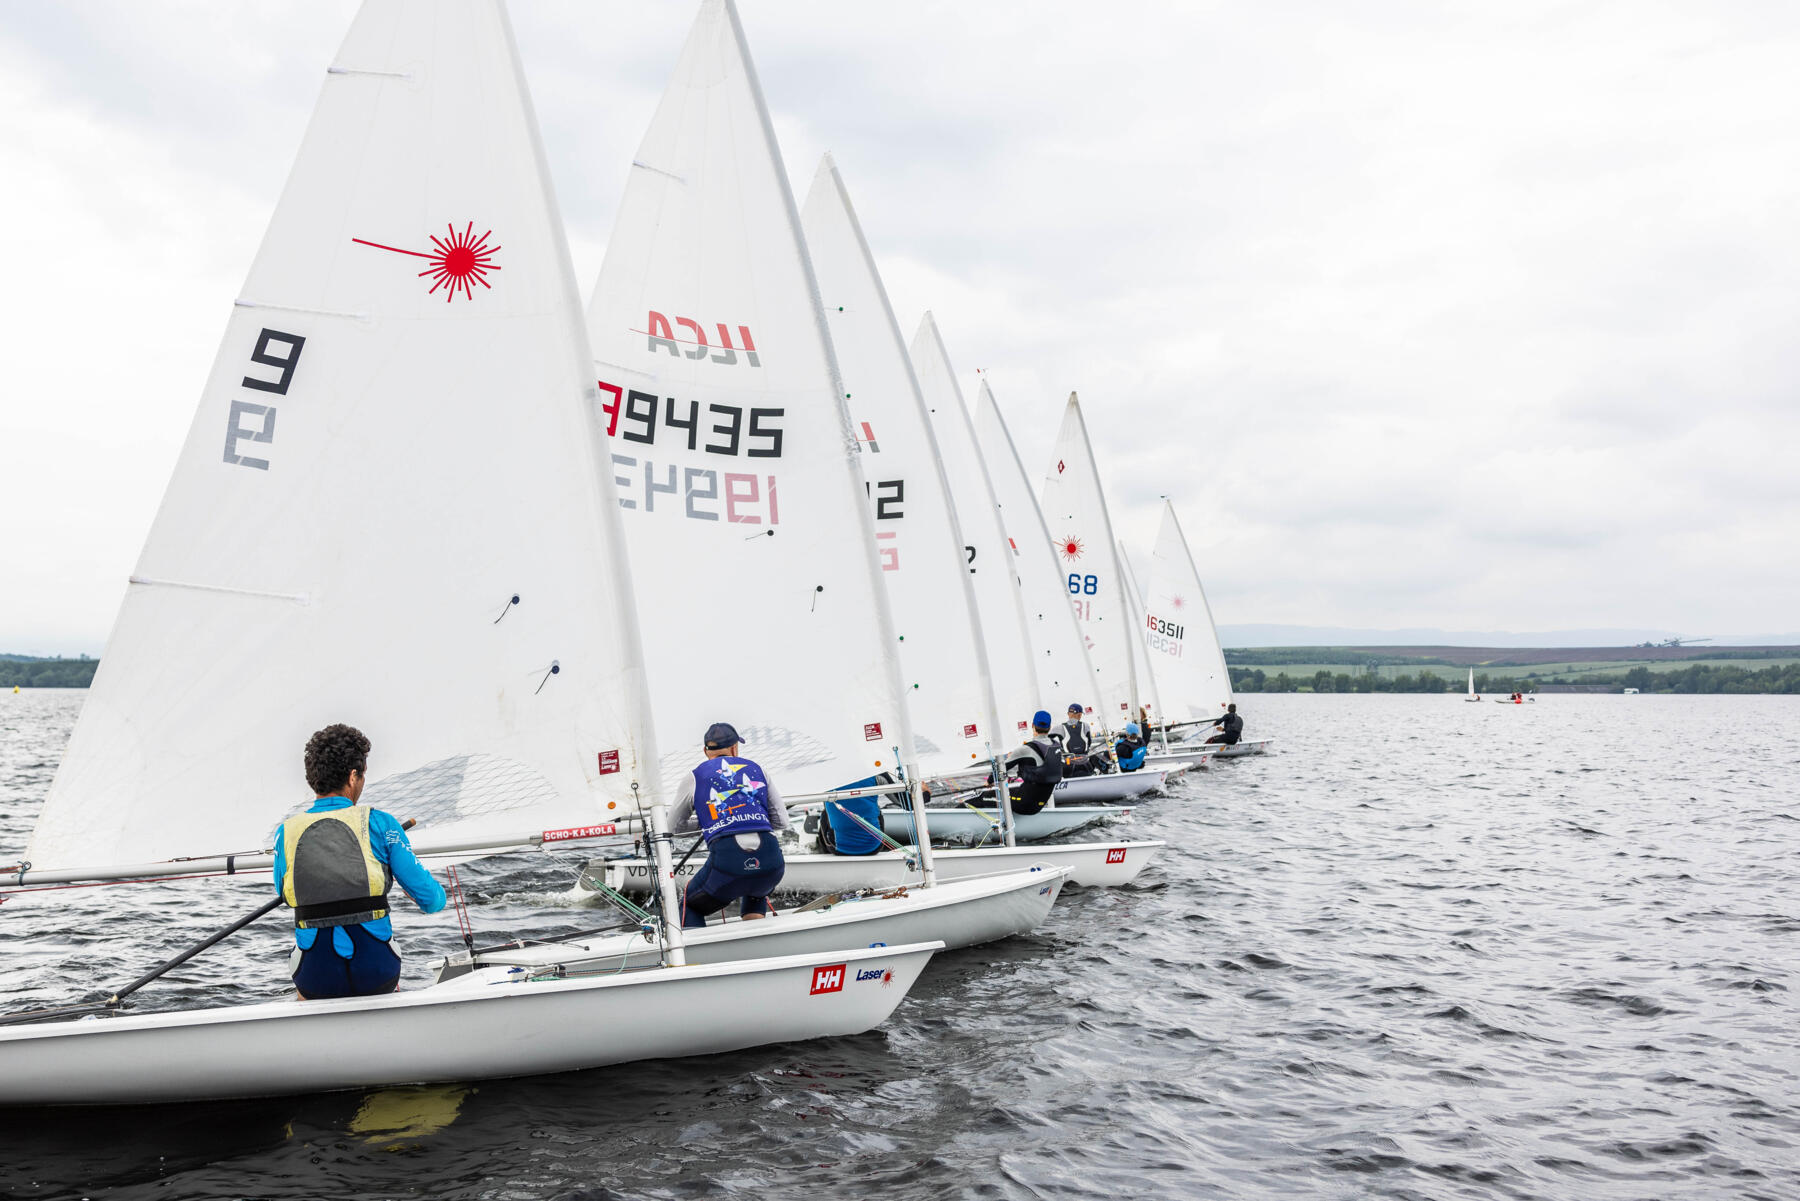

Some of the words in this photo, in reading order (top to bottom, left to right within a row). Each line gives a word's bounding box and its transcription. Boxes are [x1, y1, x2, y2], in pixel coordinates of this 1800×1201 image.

[242, 328, 306, 395] 9
[866, 480, 904, 520] 2
[1068, 573, 1098, 595] 68
[1147, 614, 1184, 640] 163511
[726, 813, 761, 825] SAILING
[1108, 851, 1124, 861] HH
[815, 969, 842, 989] HH
[856, 968, 885, 982] Laser
